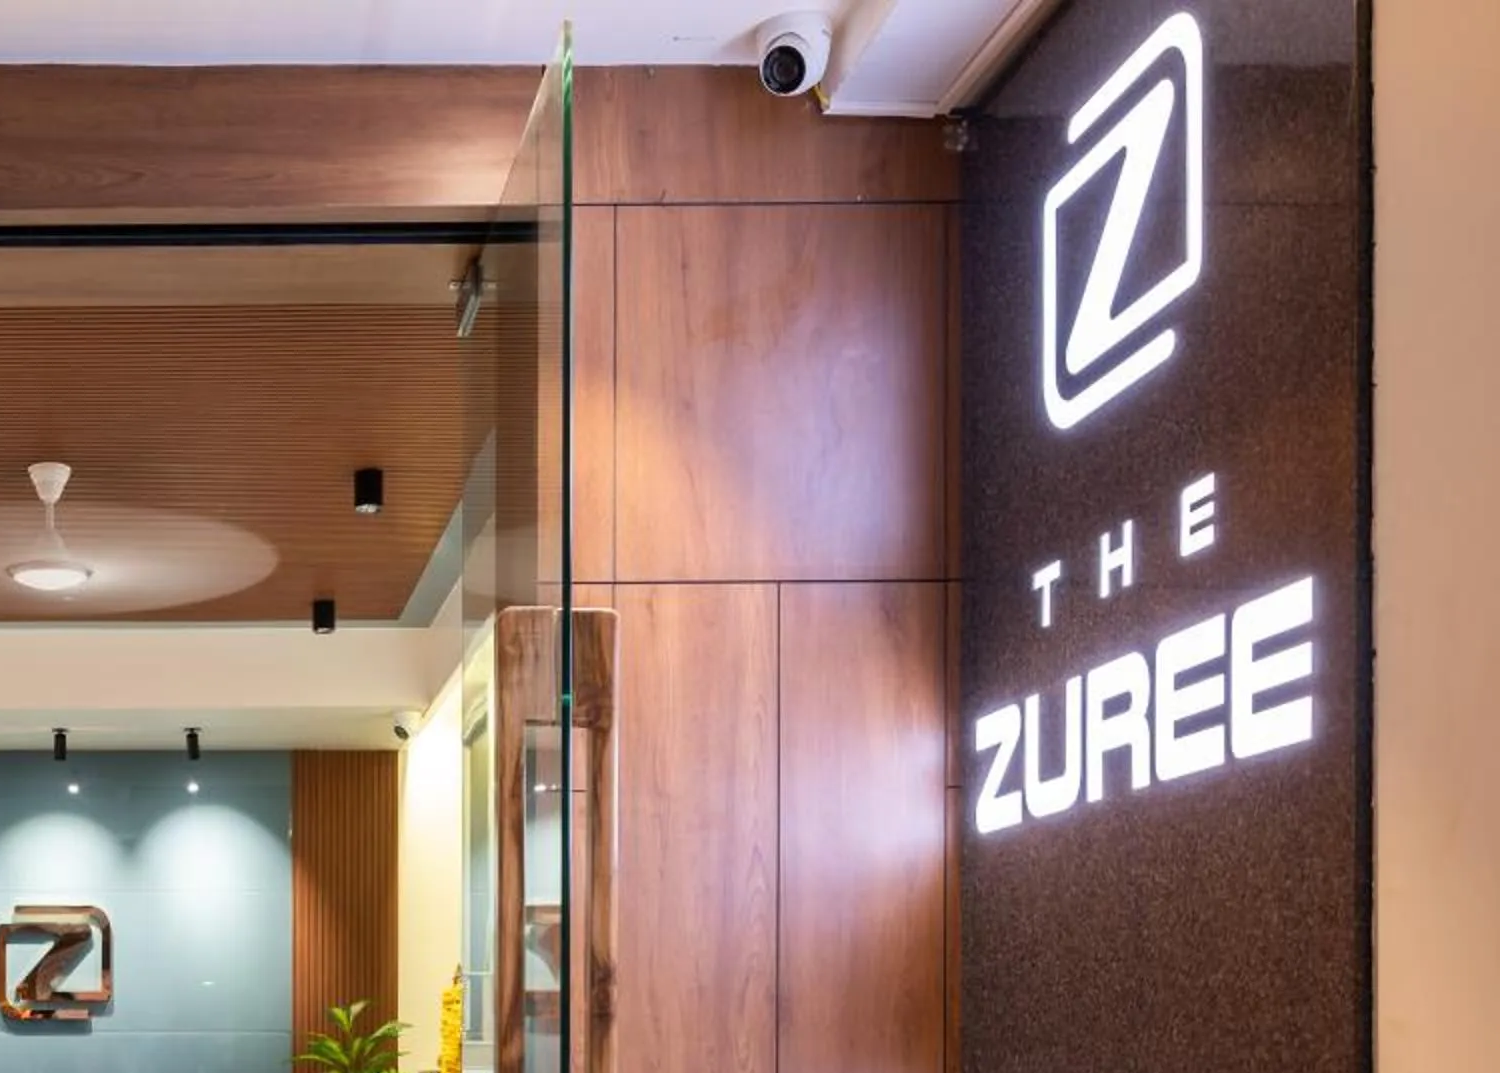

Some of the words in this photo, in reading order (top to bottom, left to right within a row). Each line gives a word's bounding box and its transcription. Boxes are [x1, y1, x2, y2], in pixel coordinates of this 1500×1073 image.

[1043, 11, 1203, 430] Z
[1032, 472, 1215, 628] THE
[974, 575, 1313, 835] ZUREE
